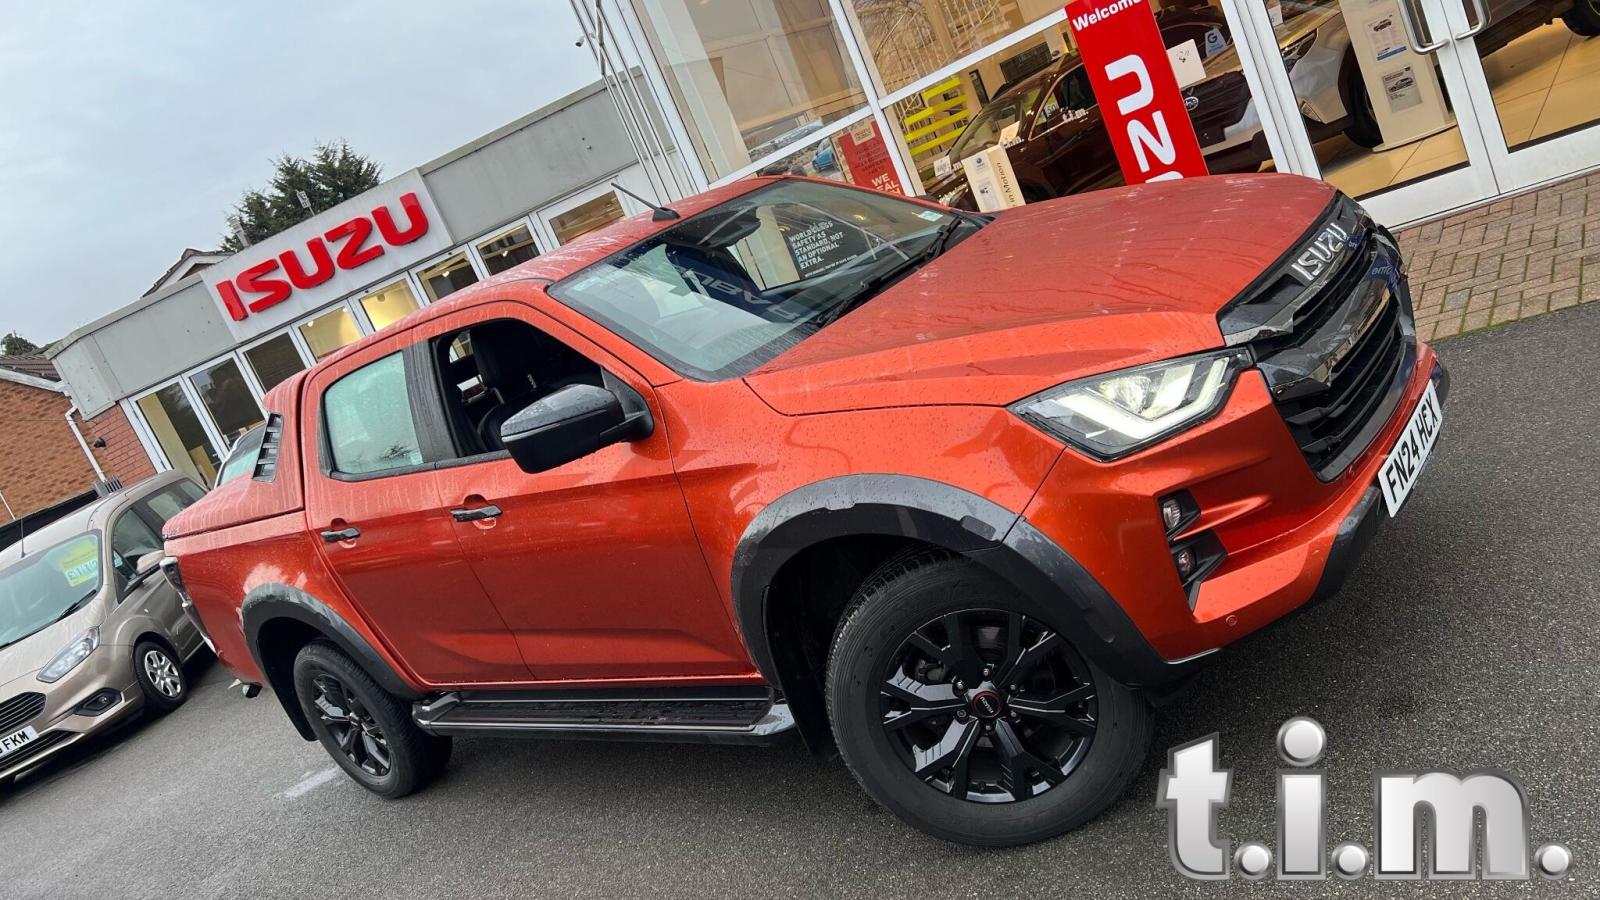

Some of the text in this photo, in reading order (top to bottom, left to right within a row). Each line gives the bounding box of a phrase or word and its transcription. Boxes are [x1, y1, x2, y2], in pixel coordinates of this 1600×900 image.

[871, 173, 890, 187] WE
[997, 162, 1012, 193] Motion
[789, 229, 812, 242] WORLD
[792, 230, 827, 248] SAFETY AS
[830, 231, 844, 241] NOT
[216, 192, 429, 321] ISUZU
[797, 242, 840, 263] AN OPTIONAL
[1291, 222, 1347, 281] ISUZU
[799, 255, 825, 270] EXTRA.
[1386, 391, 1438, 504] FN24 HEX
[1, 730, 30, 750] FKM
